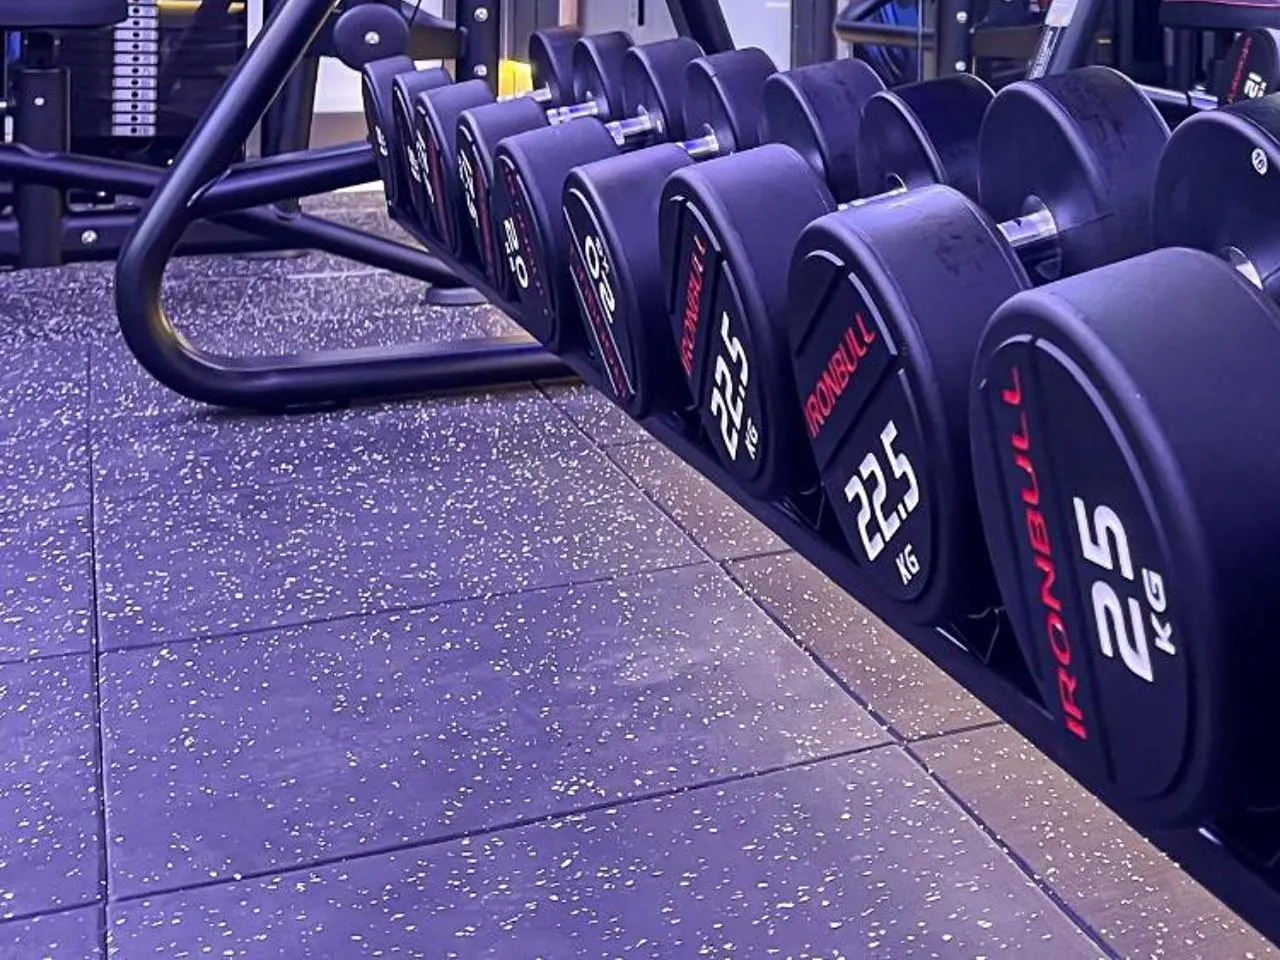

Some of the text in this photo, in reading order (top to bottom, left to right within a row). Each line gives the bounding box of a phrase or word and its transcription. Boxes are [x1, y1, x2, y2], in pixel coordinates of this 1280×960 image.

[710, 311, 749, 461] 22.5
[744, 417, 759, 460] KG
[804, 312, 876, 438] IRONBULL
[844, 419, 920, 562] 22.5
[999, 366, 1088, 741] IRONBULL
[895, 544, 921, 585] KG
[1073, 496, 1154, 683] 25
[1144, 567, 1177, 656] KG
